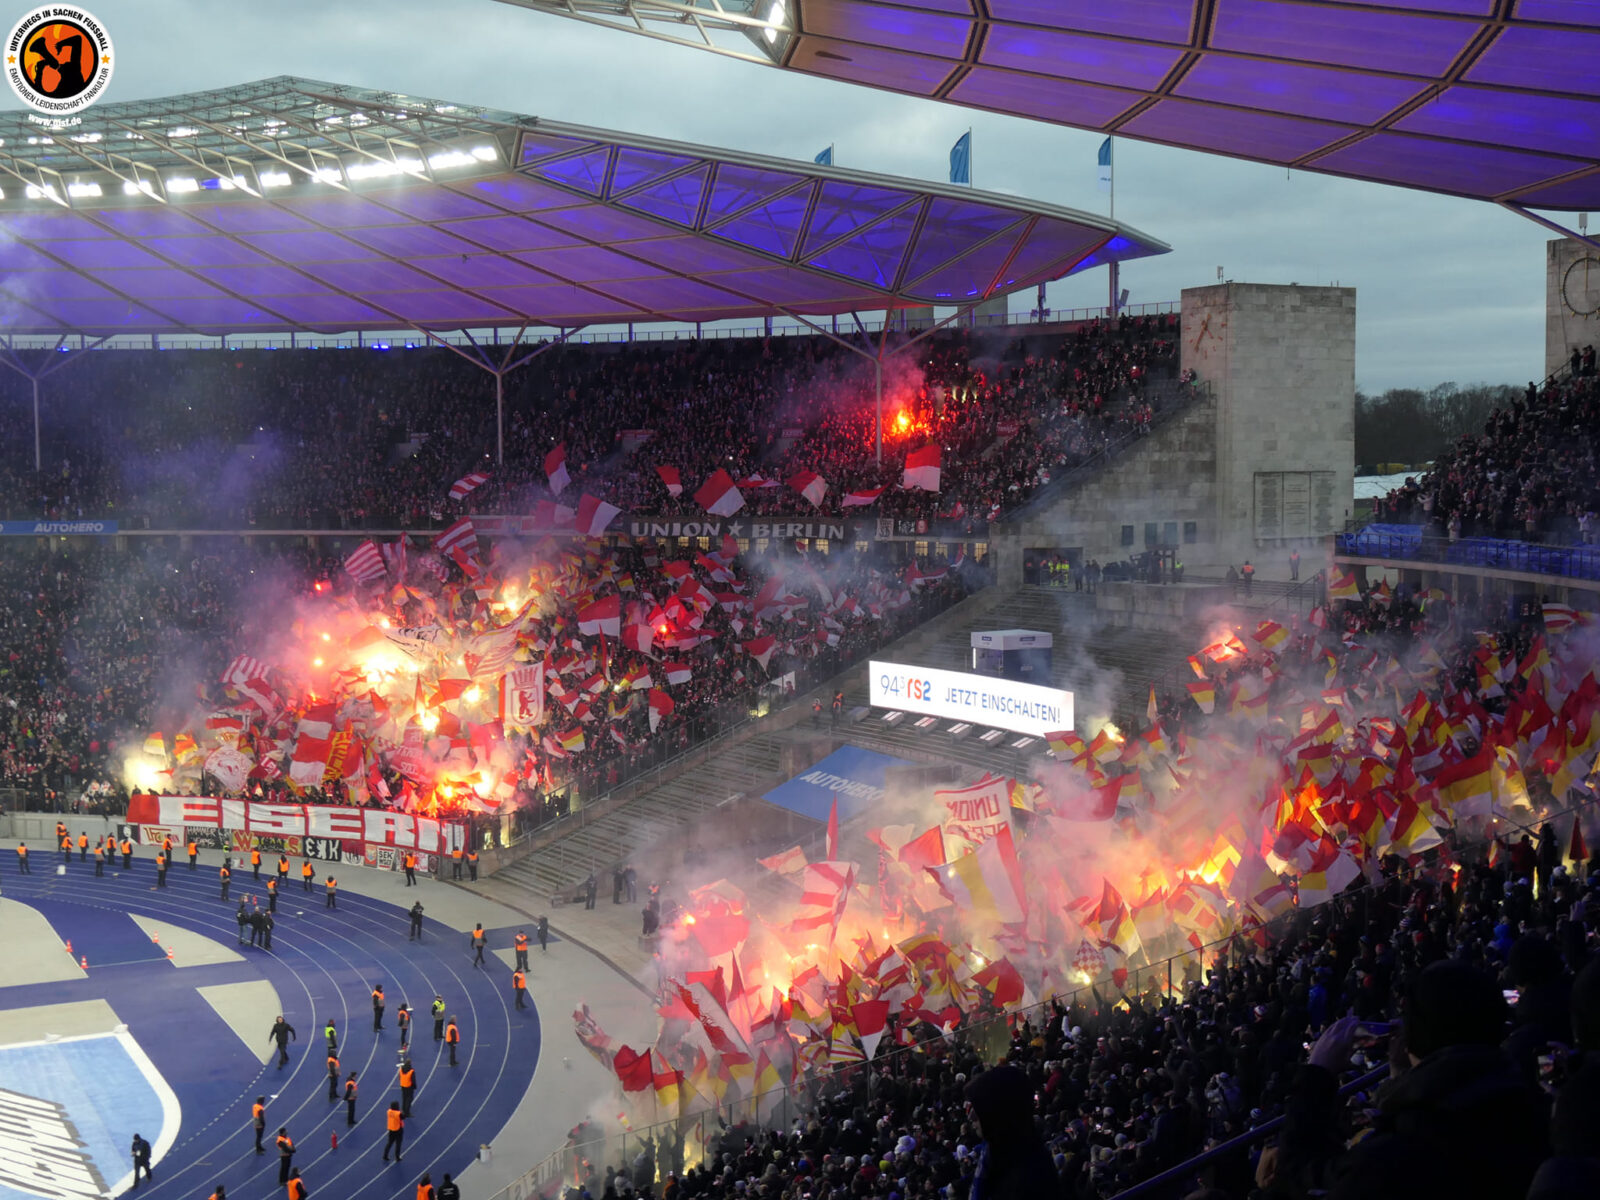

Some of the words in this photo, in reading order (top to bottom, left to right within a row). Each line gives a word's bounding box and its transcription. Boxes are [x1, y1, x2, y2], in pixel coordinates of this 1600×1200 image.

[33, 522, 104, 533] AUTOHERO
[631, 521, 721, 538] UNION
[752, 523, 845, 540] BERLIN
[945, 687, 979, 706] JETZT
[981, 693, 1061, 724] EINSCHALTEN!
[158, 796, 466, 856] EISERN
